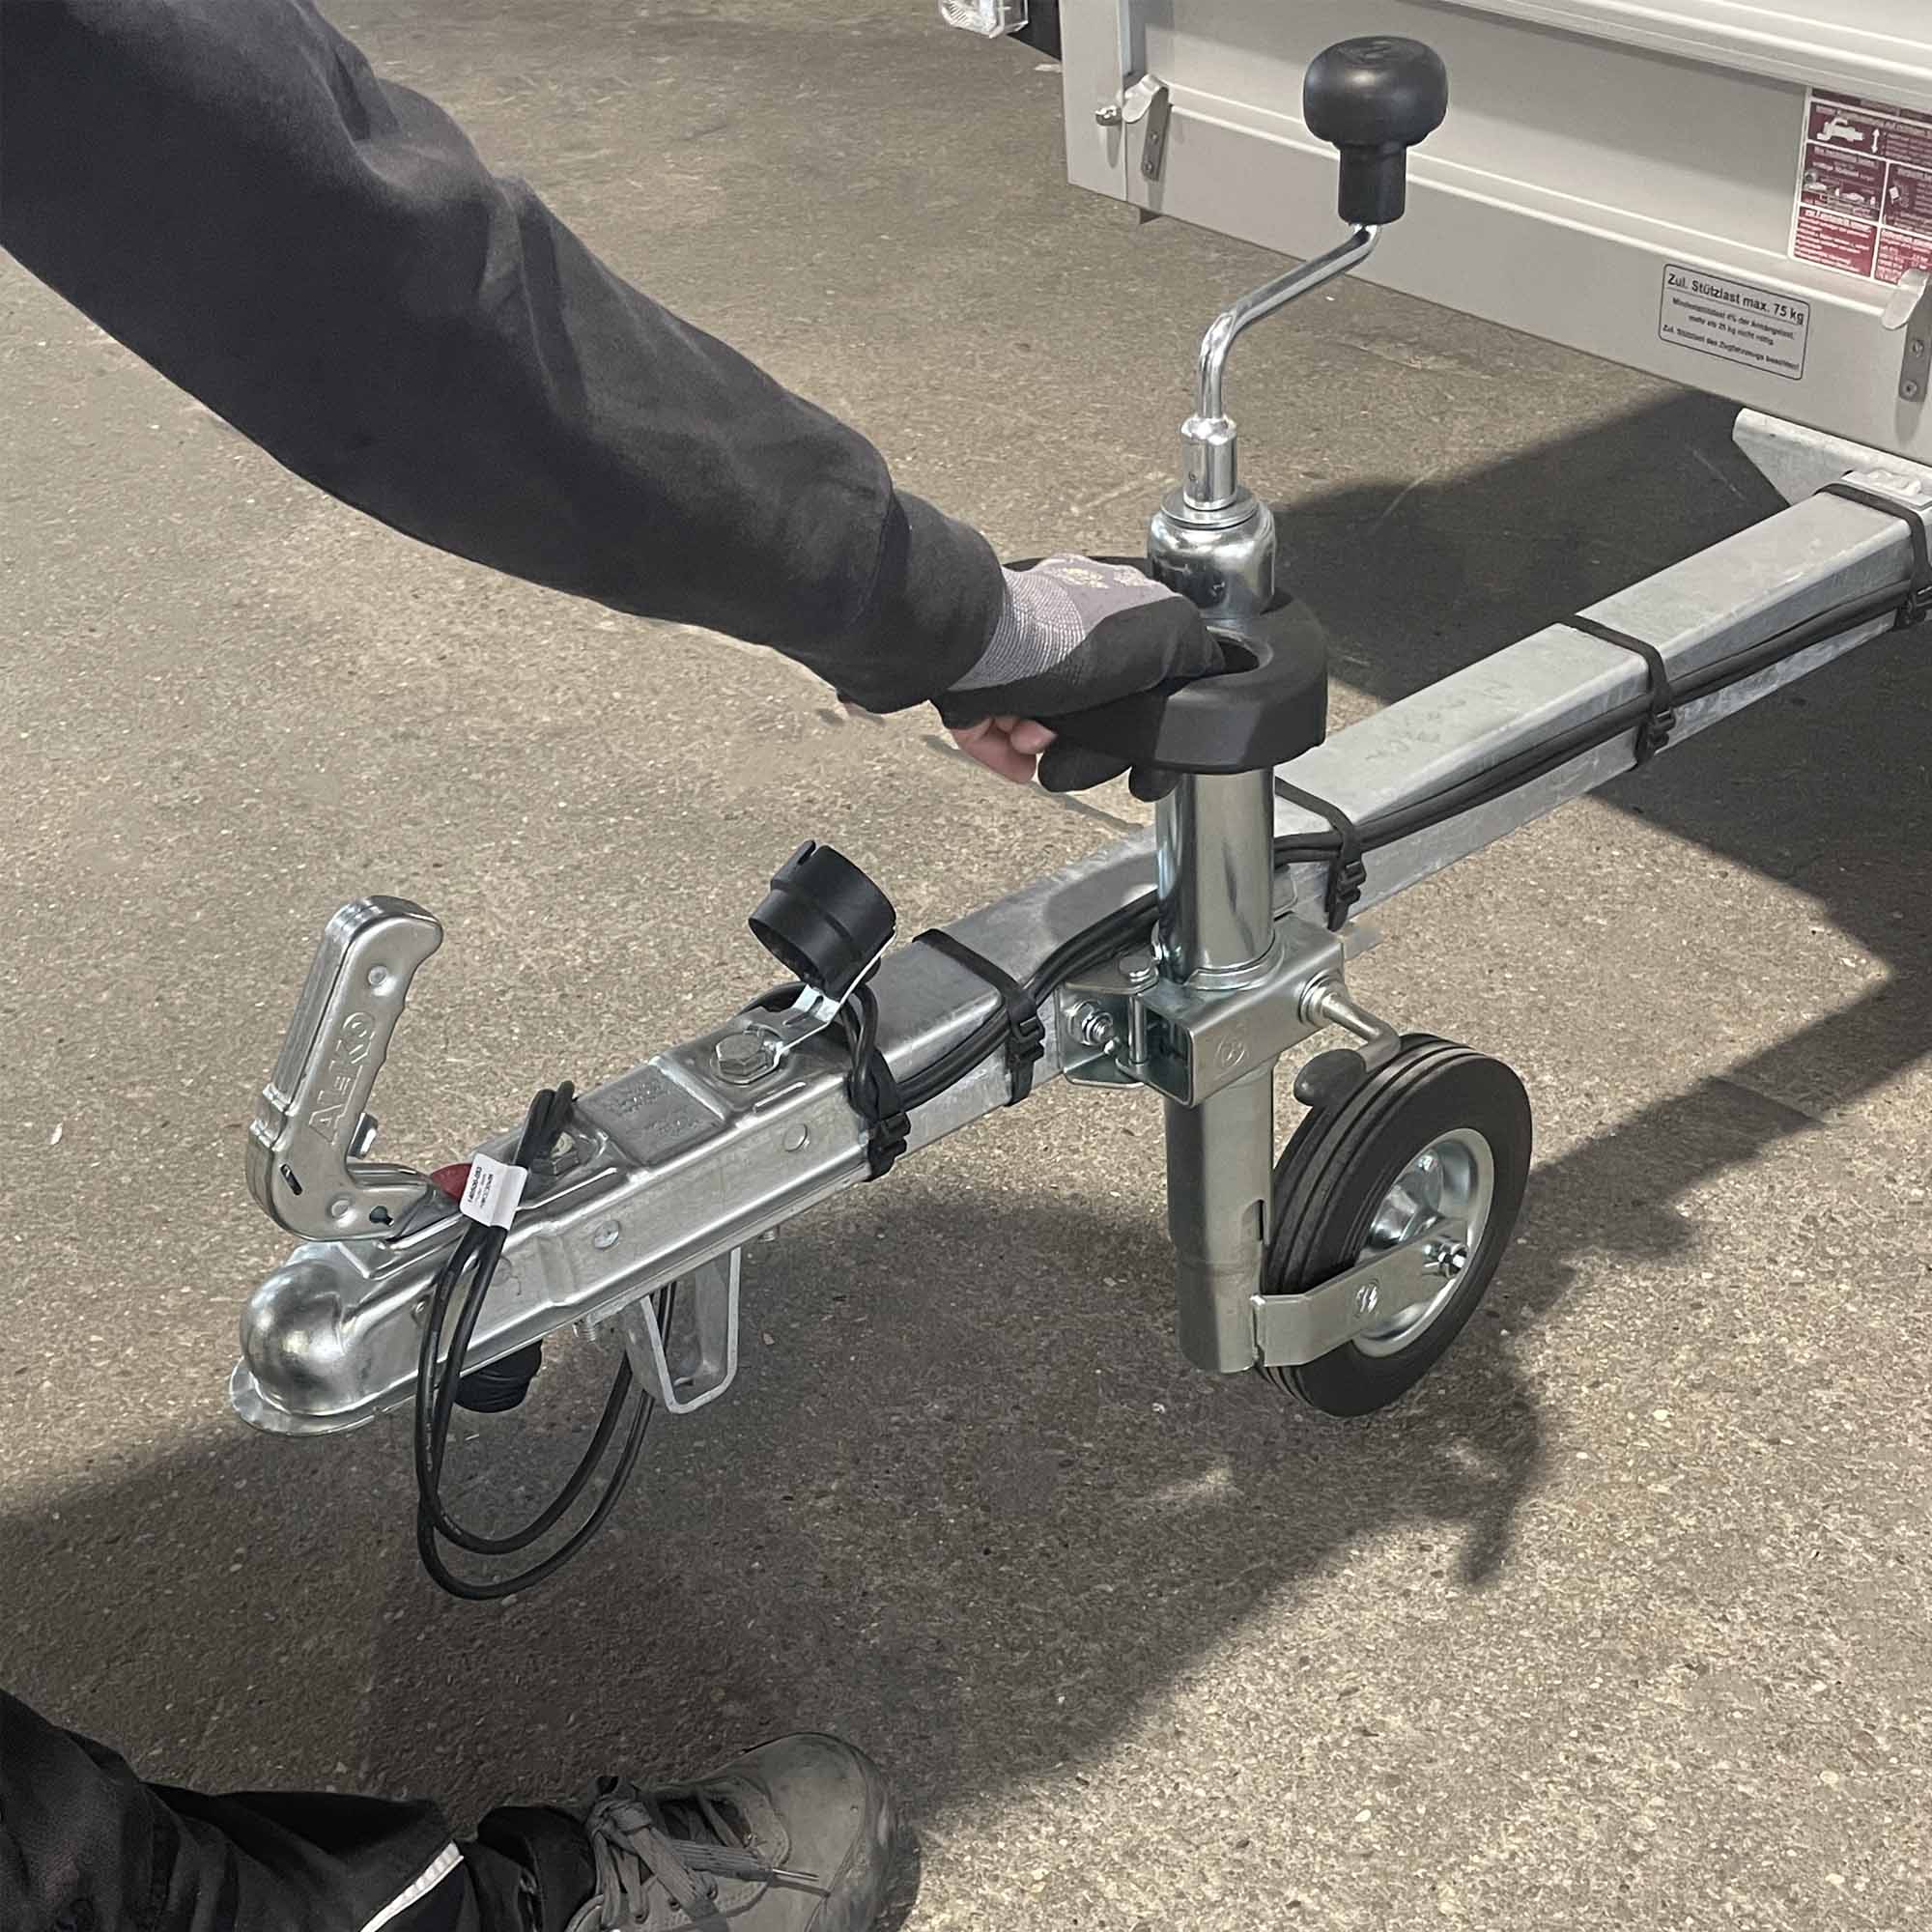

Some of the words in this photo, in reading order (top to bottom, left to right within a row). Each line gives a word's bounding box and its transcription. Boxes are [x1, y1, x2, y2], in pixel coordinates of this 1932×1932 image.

[1667, 272, 1689, 289] Zul.
[1691, 279, 1740, 304] Stützlast
[1743, 296, 1770, 312] max.
[1774, 302, 1787, 318] 75
[1789, 307, 1804, 326] kg
